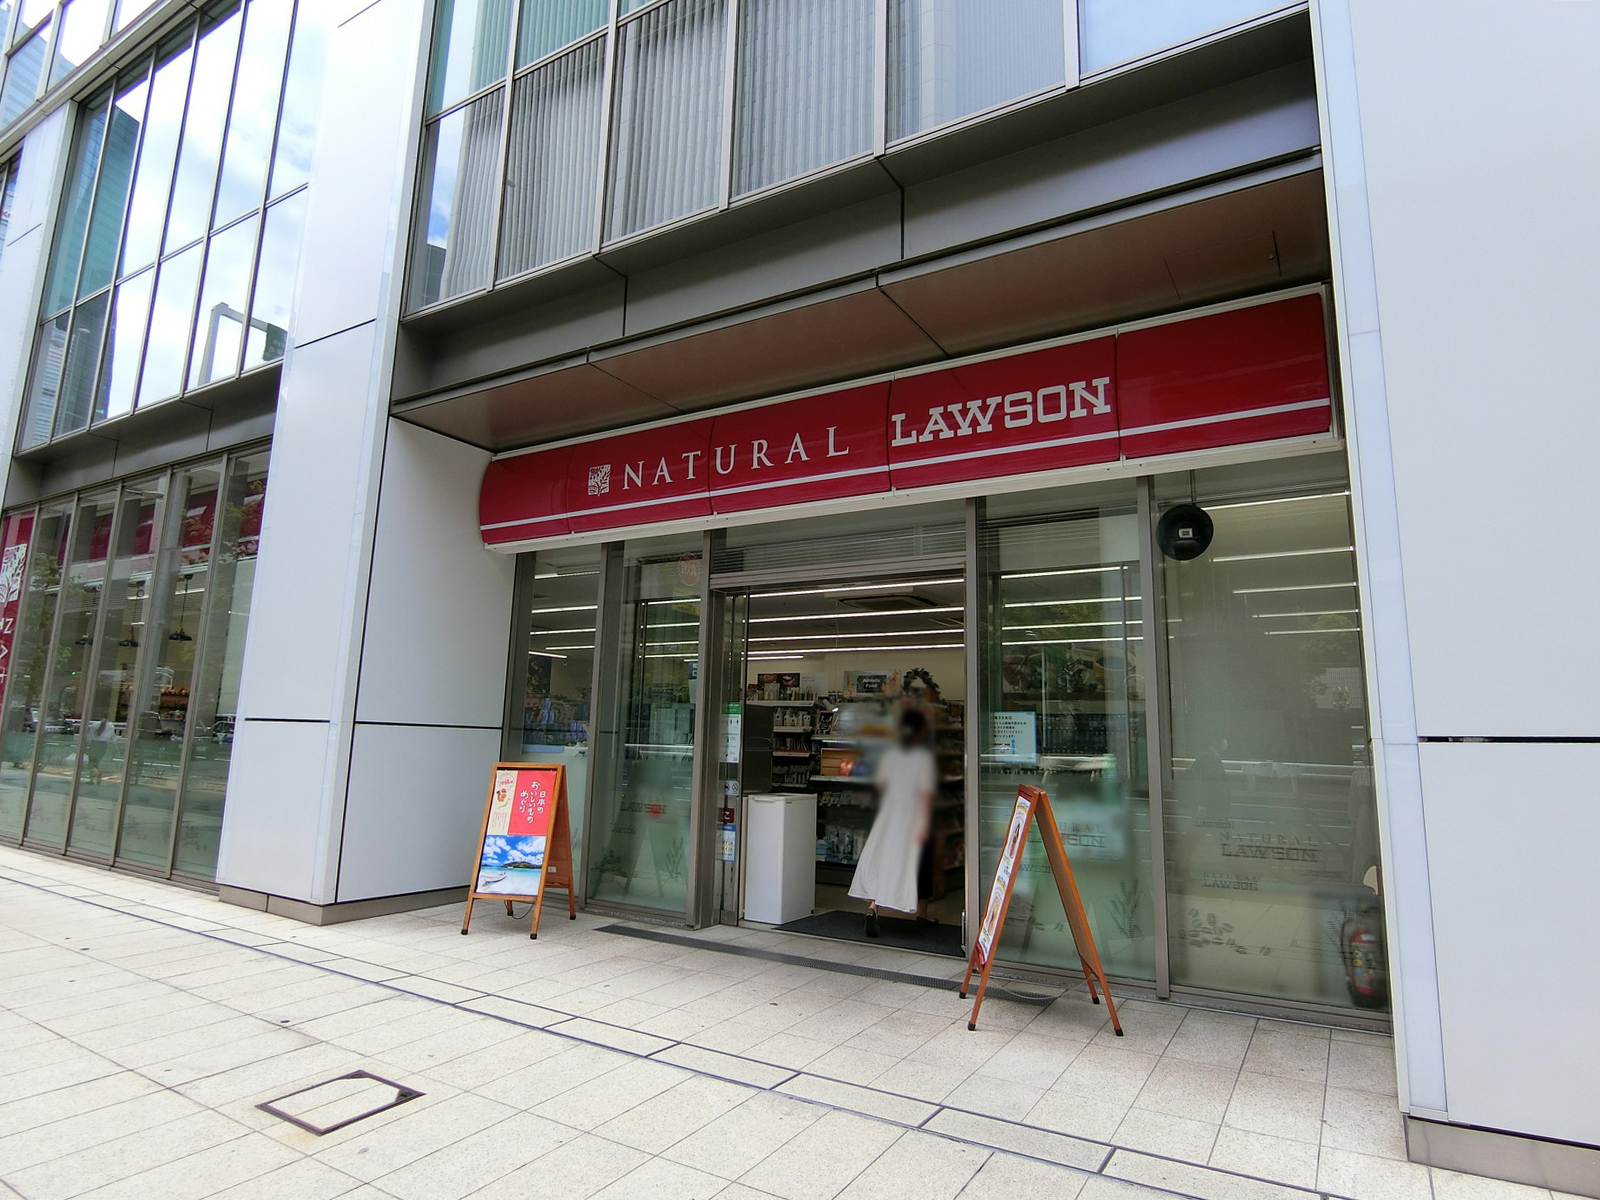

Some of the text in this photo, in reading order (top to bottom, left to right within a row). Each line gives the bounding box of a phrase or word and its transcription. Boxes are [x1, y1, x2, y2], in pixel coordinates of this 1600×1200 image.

[622, 376, 1111, 490] NATURAL LAWSON
[519, 789, 529, 813] めぐり
[527, 781, 541, 824] おいしいもの
[537, 790, 546, 813] 日本の
[1220, 832, 1319, 847] NATURAL
[1220, 843, 1322, 863] LAWSON
